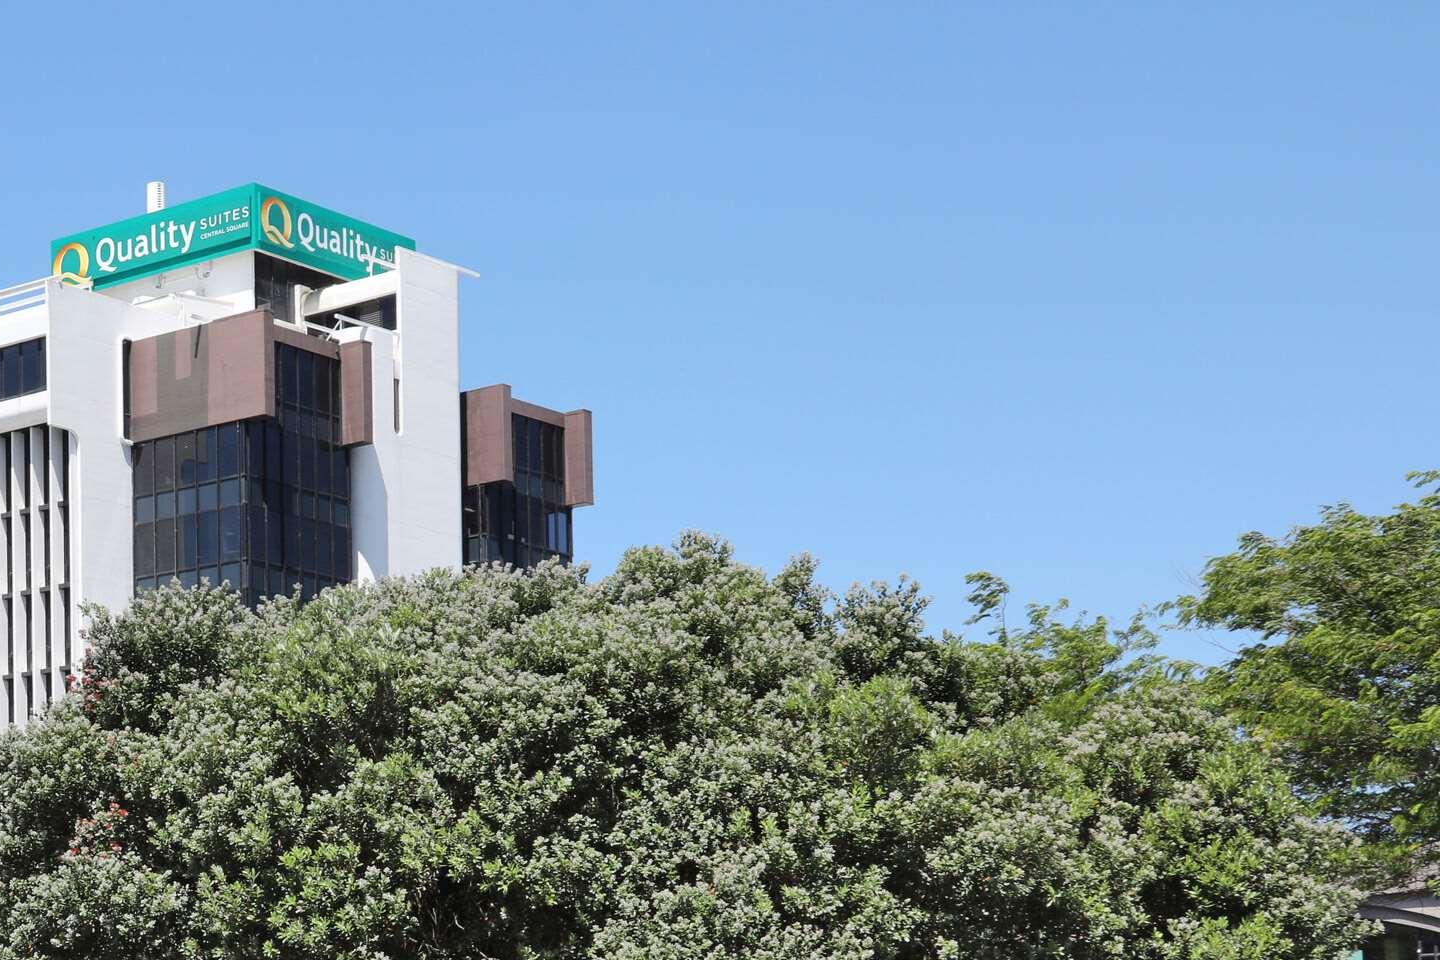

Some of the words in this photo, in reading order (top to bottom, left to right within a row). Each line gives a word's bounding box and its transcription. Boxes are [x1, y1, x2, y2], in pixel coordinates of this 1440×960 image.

[95, 220, 196, 272] Quality
[200, 206, 249, 230] SUITES
[298, 212, 378, 273] Quality
